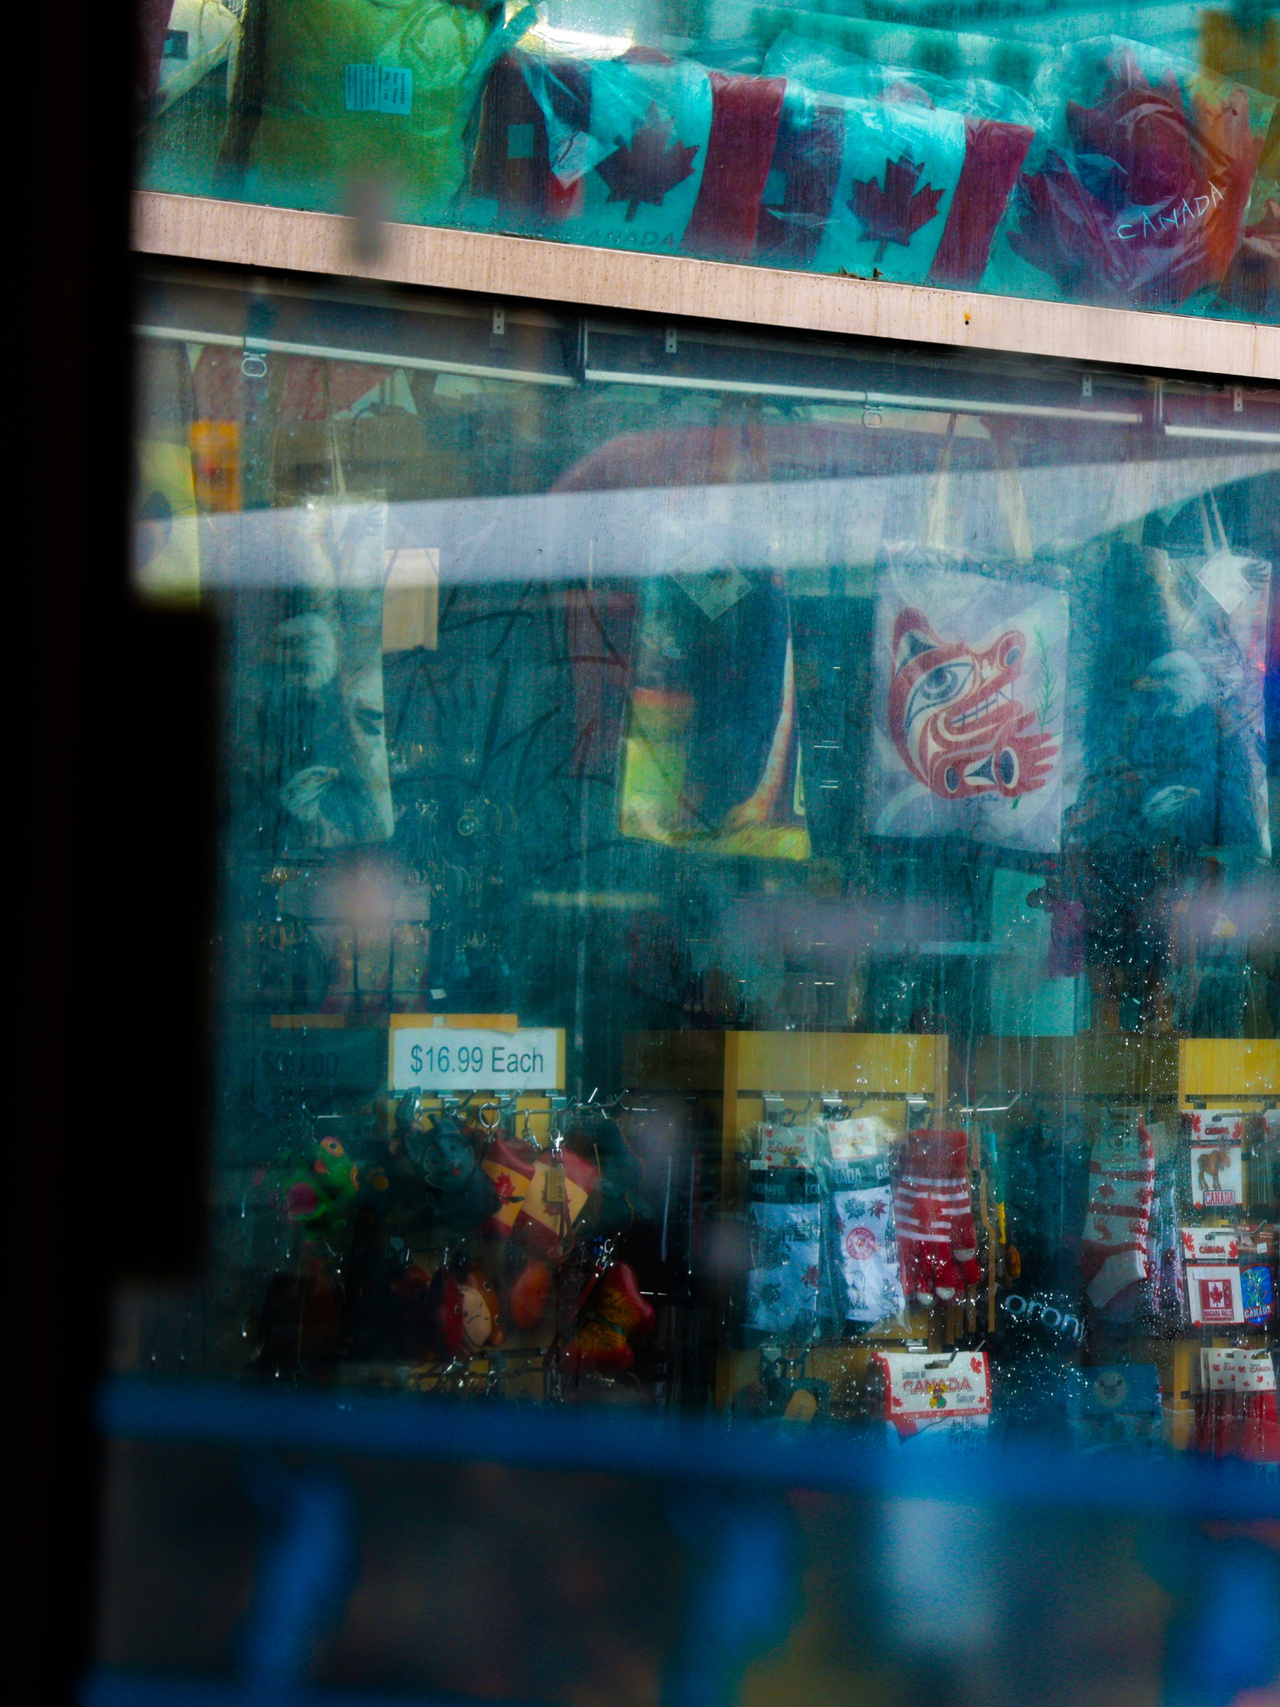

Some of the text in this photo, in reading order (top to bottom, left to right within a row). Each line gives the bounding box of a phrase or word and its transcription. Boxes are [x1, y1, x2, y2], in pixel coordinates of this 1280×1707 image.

[1117, 180, 1225, 239] CANADA
[410, 1043, 544, 1077] $16.99 Each
[1205, 1191, 1235, 1205] CANADA
[1244, 1304, 1272, 1319] CANADA
[902, 1377, 974, 1394] CANADA
